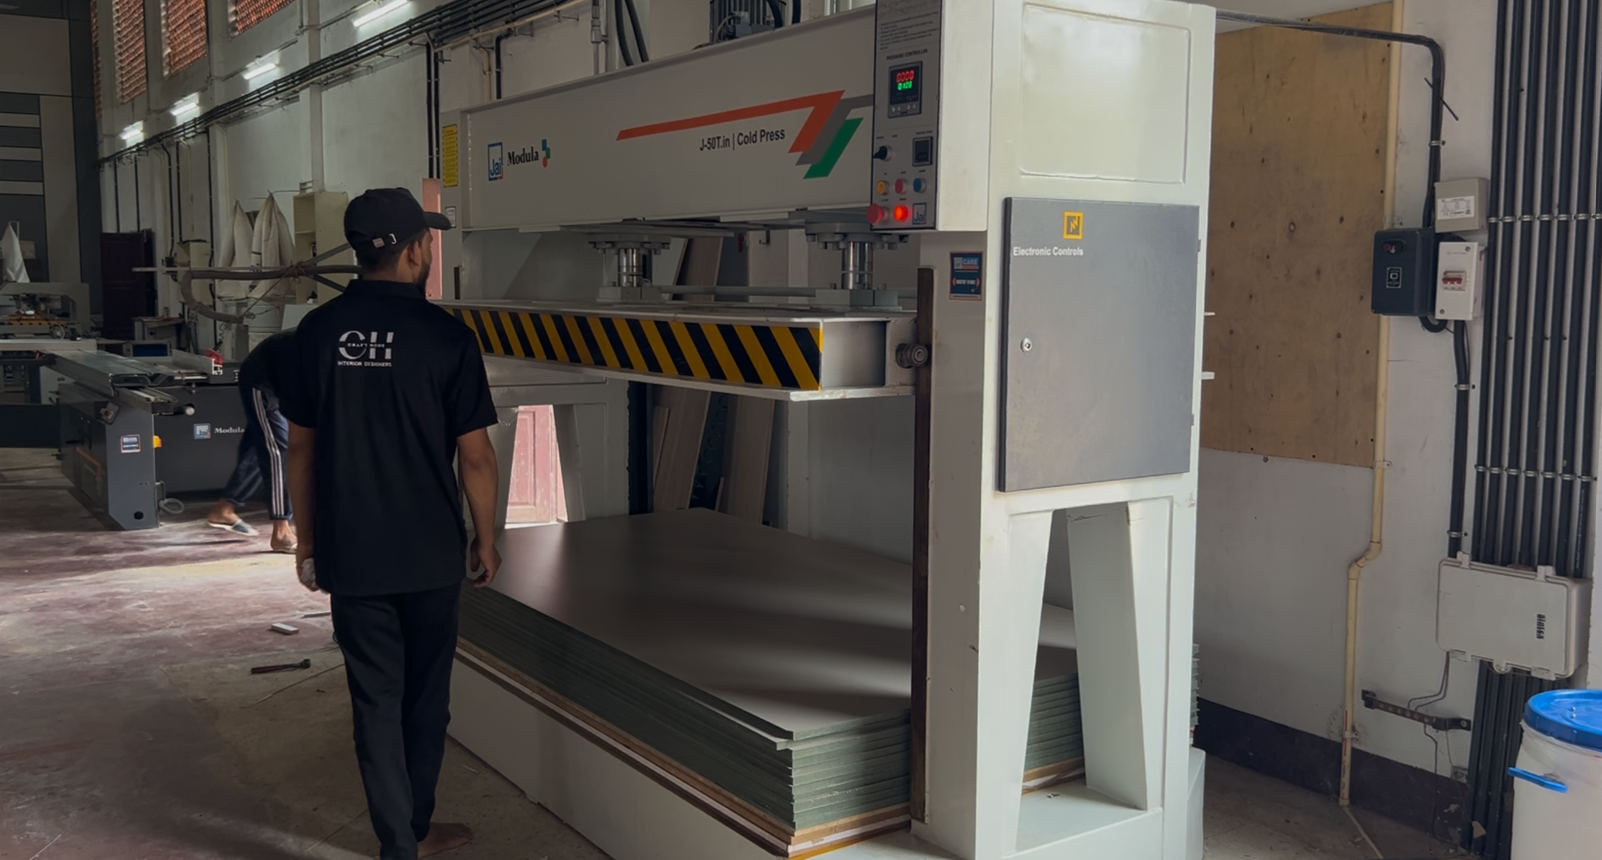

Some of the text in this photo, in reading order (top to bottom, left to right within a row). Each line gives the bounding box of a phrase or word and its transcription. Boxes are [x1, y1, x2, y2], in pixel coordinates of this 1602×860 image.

[699, 136, 731, 151] J-50T.in
[737, 130, 758, 146] Cold
[760, 129, 785, 142] Press
[507, 146, 539, 166] Modula
[1013, 246, 1084, 256] Electronic Controls
